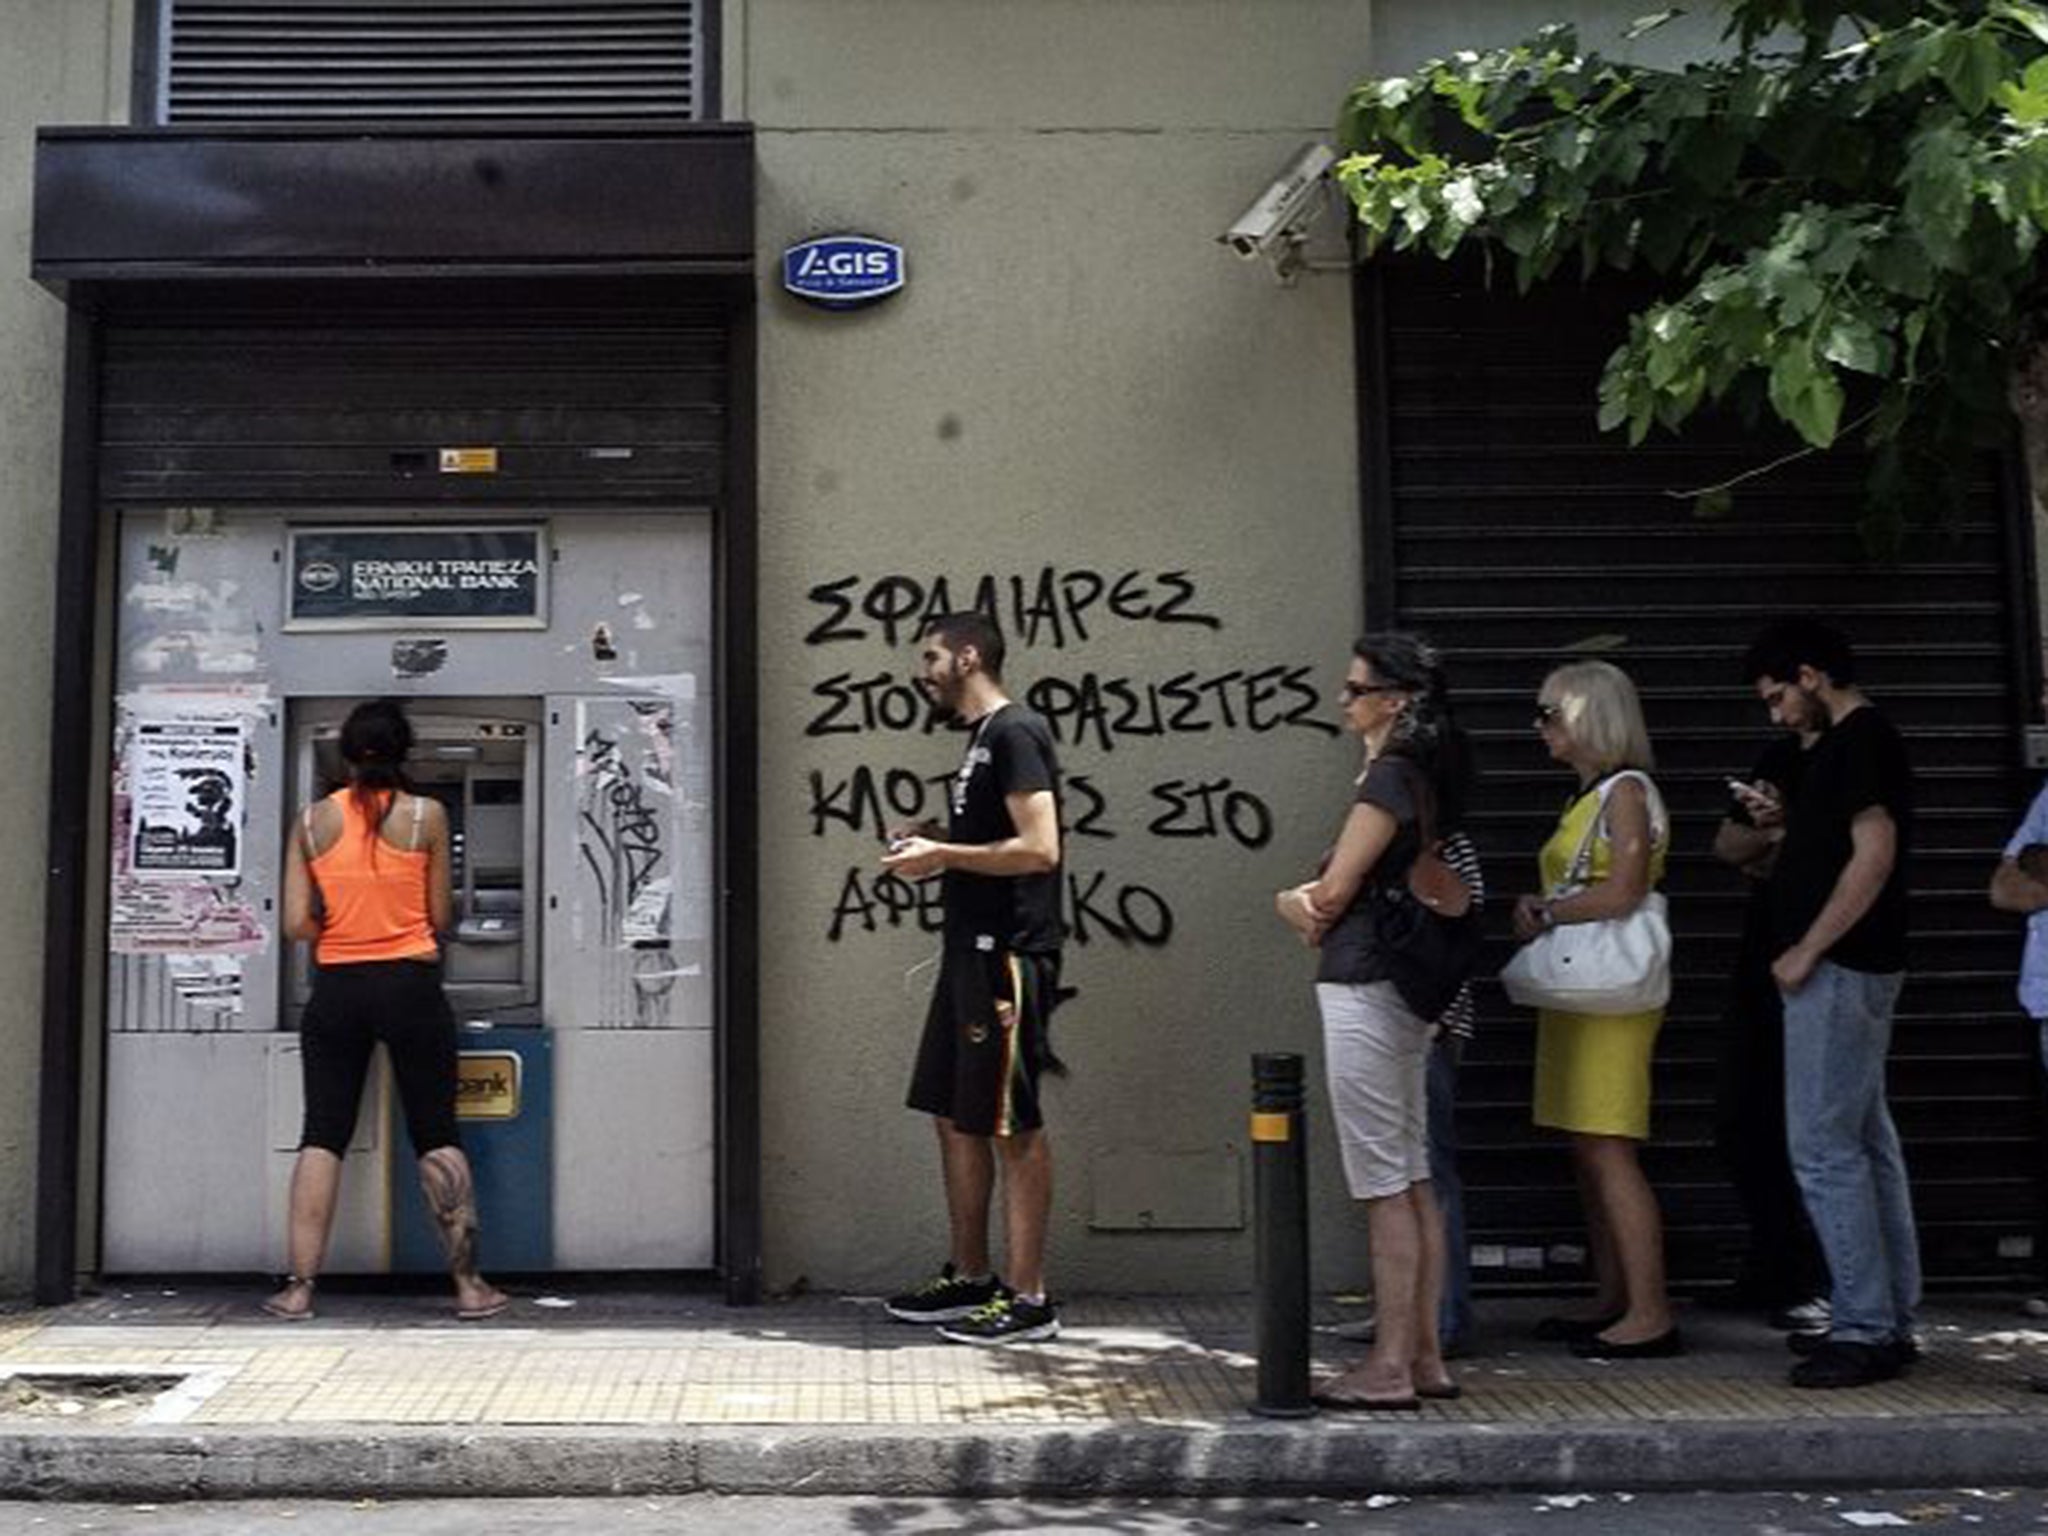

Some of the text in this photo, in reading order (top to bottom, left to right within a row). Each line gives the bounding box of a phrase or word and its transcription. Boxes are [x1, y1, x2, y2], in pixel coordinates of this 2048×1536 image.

[798, 248, 889, 276] AGIS
[353, 575, 519, 589] NATIONAL BANK
[1026, 666, 1343, 750] ΦΑΣΙΣΤΕΣ
[1149, 778, 1272, 850] ΣΤΟ
[827, 866, 1173, 947] ΑΦΕΚΟ
